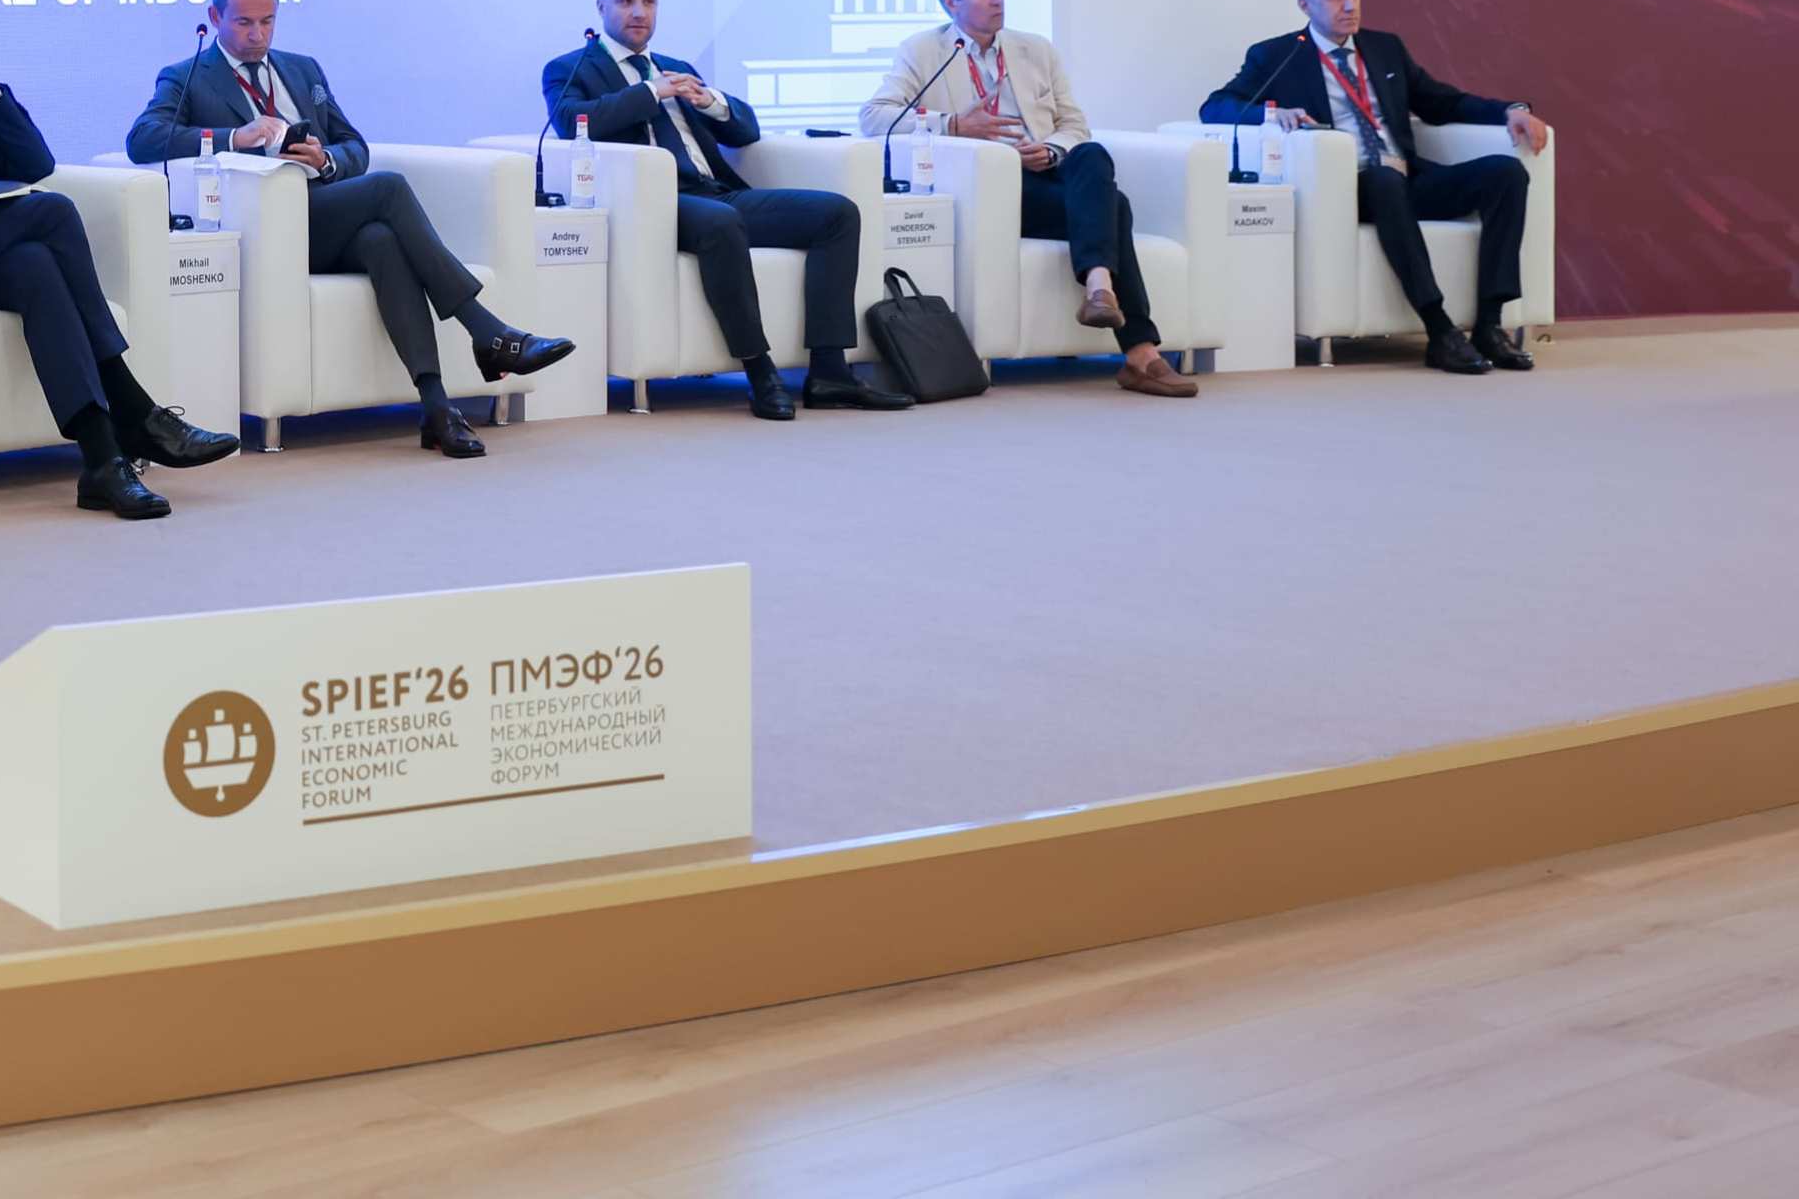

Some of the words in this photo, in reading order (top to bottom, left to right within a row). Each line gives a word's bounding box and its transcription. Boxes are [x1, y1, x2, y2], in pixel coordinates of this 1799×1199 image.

[543, 246, 589, 257] TOMYSHEV
[552, 231, 580, 243] Andrey
[169, 272, 224, 286] IMOSHENKO
[179, 257, 210, 269] Mikhail
[490, 645, 665, 696] ПМЭФ'26
[301, 664, 469, 718] SPIEF'26
[491, 685, 643, 722] ПЕТЕРБУРГСКИЙ
[301, 723, 326, 744] ST.
[330, 710, 453, 741] PETERSBURG
[491, 706, 666, 744] МЕЖДУНАРОДНЫЙ
[301, 732, 459, 766] INTERNATIONAL
[491, 727, 663, 765] ЭКОНОМИЧЕСКИЙ
[301, 759, 409, 789] ECONOMIC
[491, 761, 560, 786] ФОРУМ
[301, 785, 372, 809] FORUM
